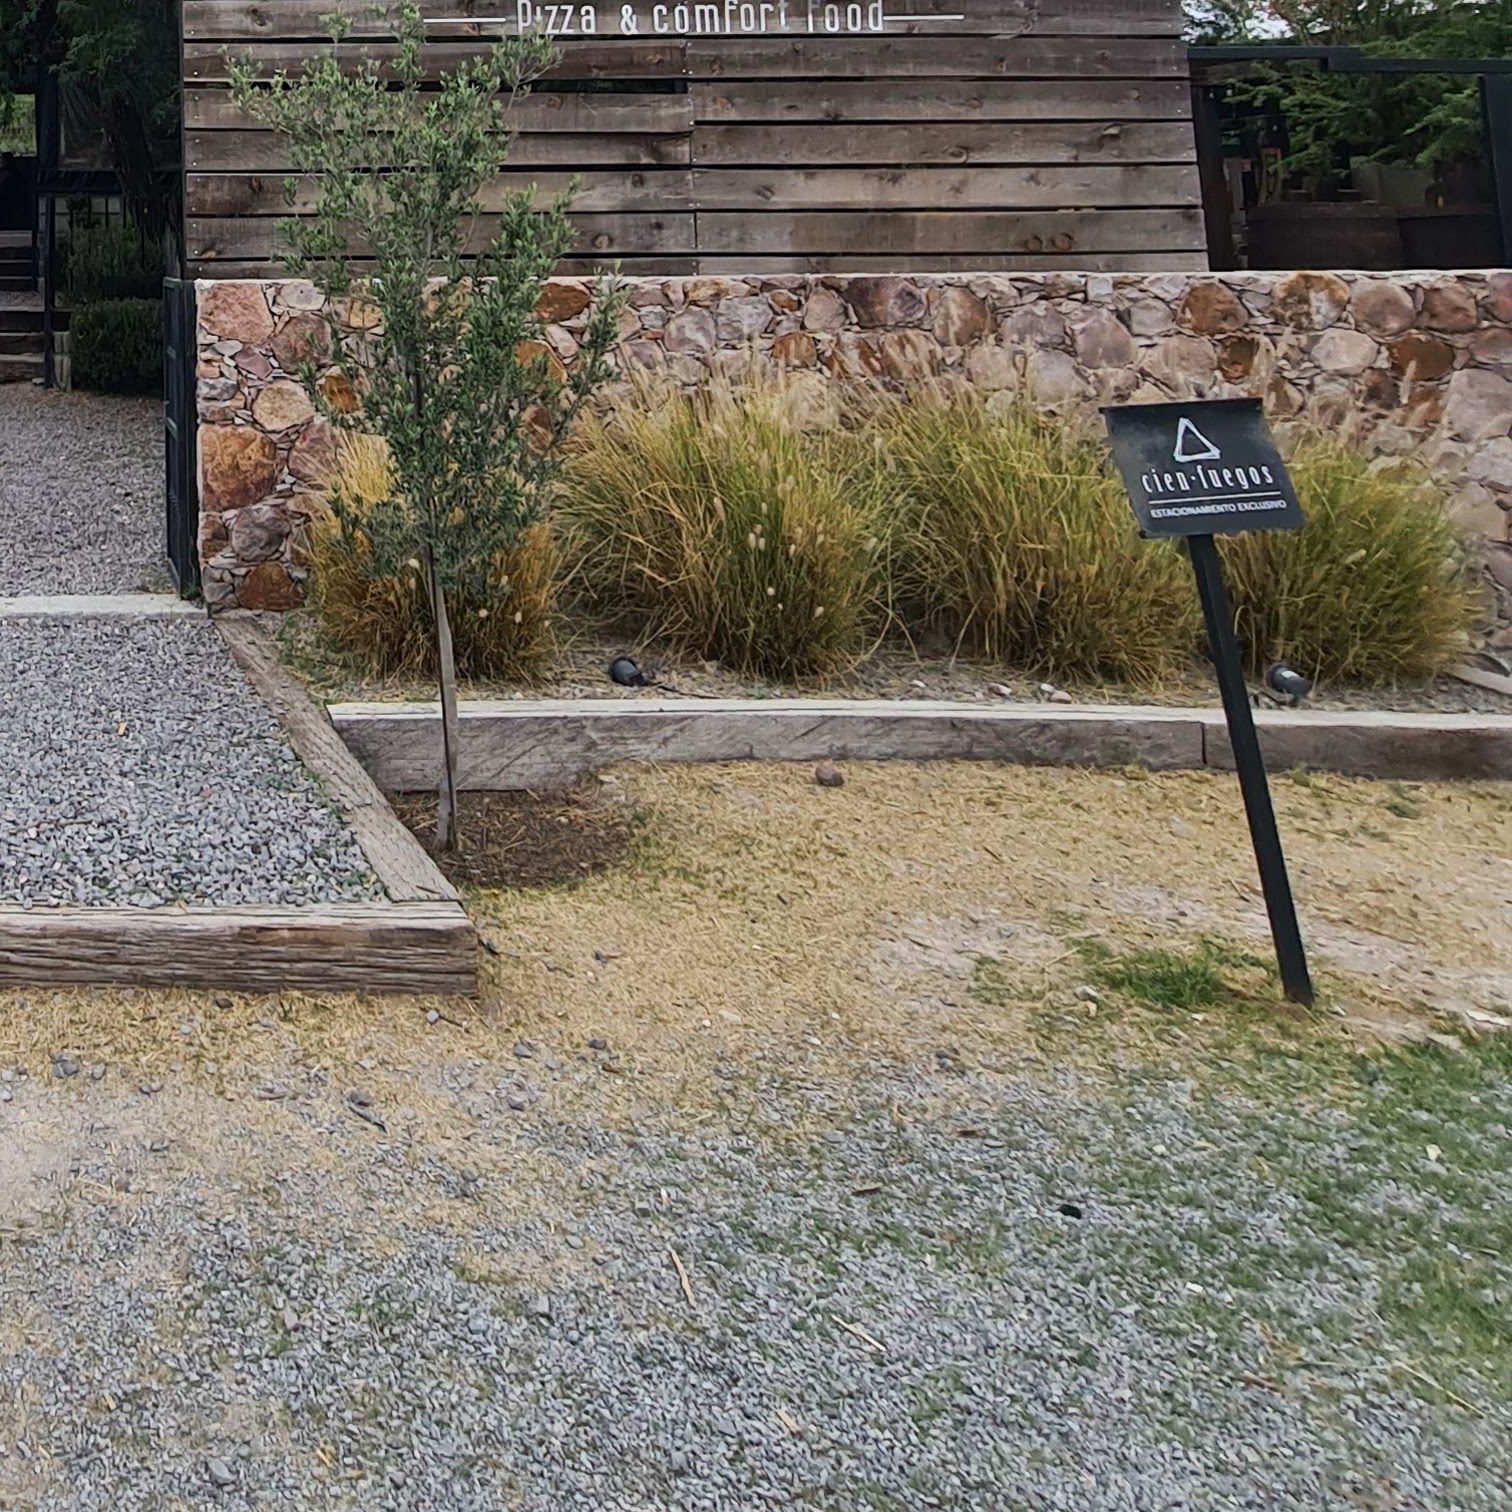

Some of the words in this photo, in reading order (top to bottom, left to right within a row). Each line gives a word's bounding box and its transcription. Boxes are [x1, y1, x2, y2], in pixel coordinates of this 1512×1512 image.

[620, 4, 639, 35] &
[1150, 502, 1236, 518] ESTACIONAMIENTO
[1238, 499, 1287, 512] EXCLUSIVO
